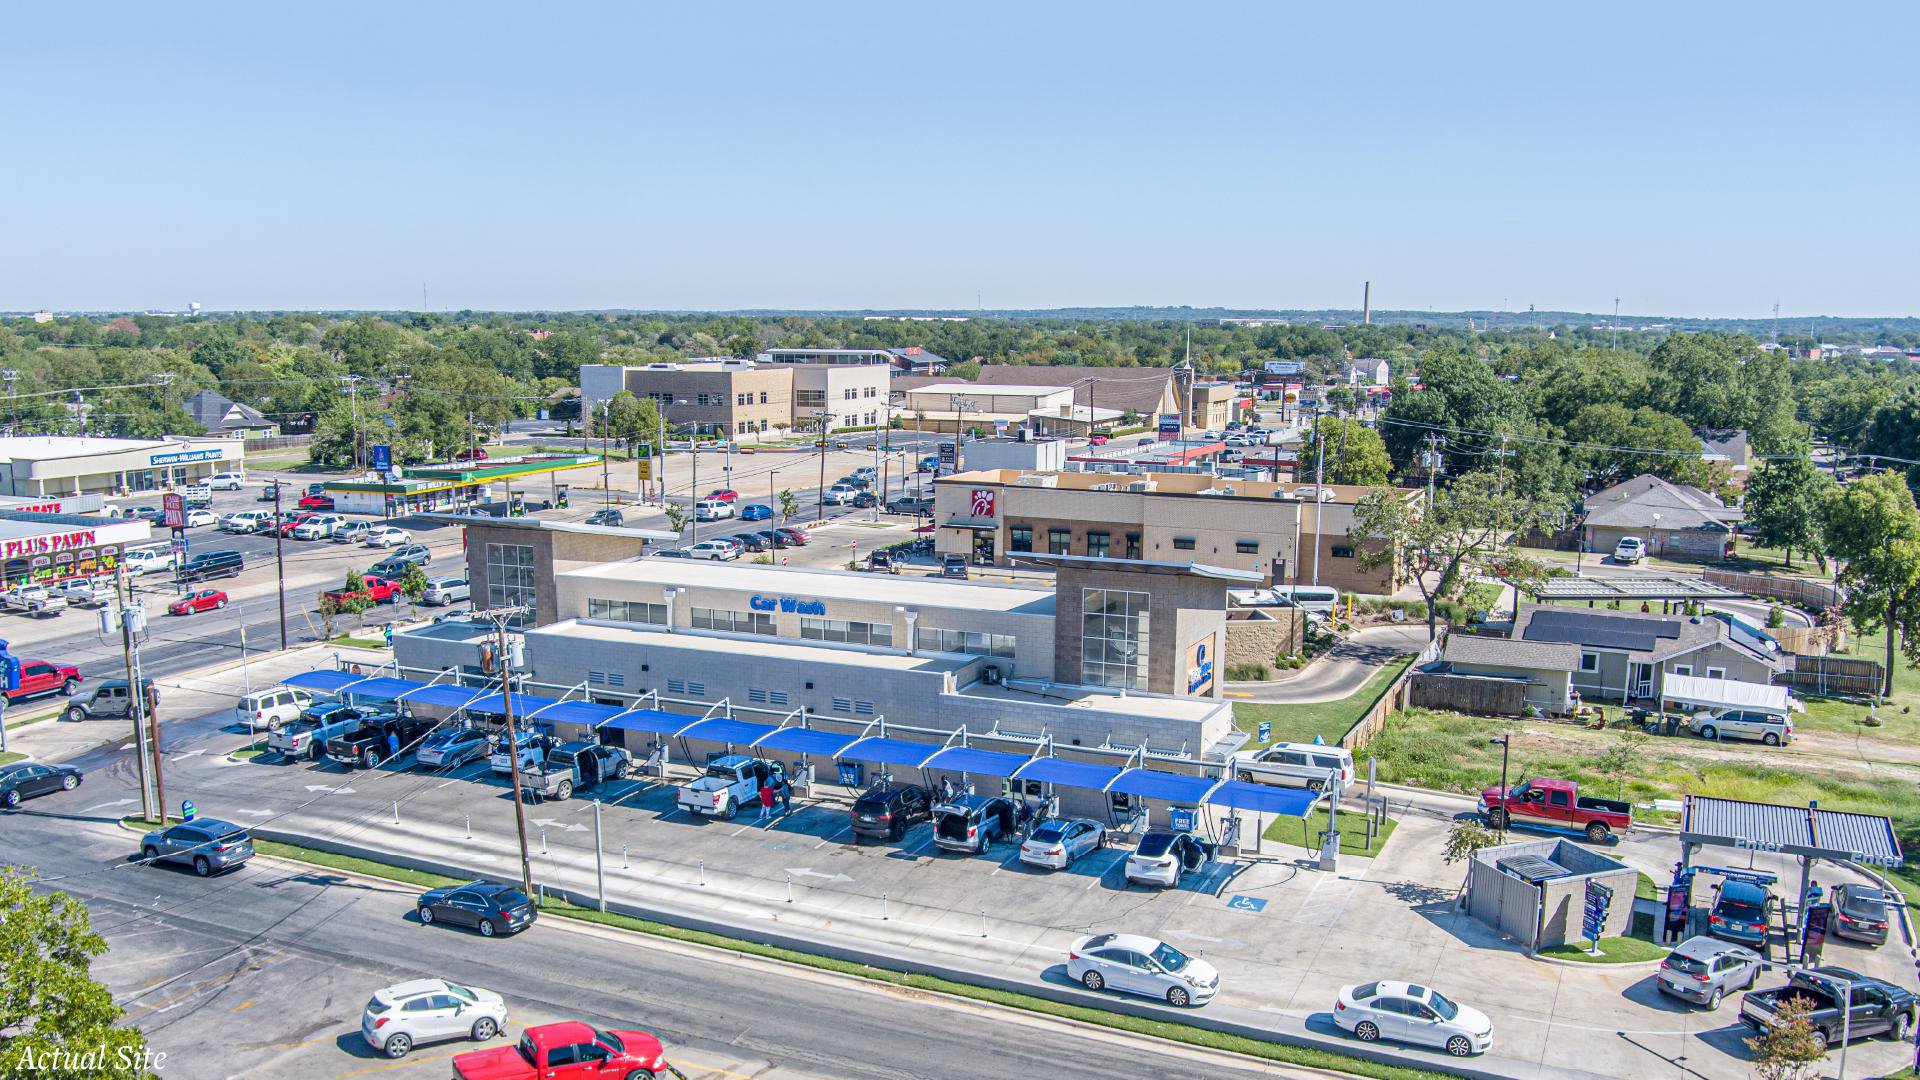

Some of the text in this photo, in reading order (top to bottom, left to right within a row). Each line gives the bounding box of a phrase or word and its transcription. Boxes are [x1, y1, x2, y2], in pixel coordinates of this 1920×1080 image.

[152, 450, 223, 464] SHERWIN-WILLIAMS PAINTS
[16, 503, 62, 513] ARATE
[166, 510, 183, 525] PAWN
[6, 536, 48, 557] PLUS
[51, 530, 96, 551] PAWN
[750, 594, 826, 616] Car Wash
[1735, 836, 1784, 853] Enter
[1851, 851, 1903, 868] Enter
